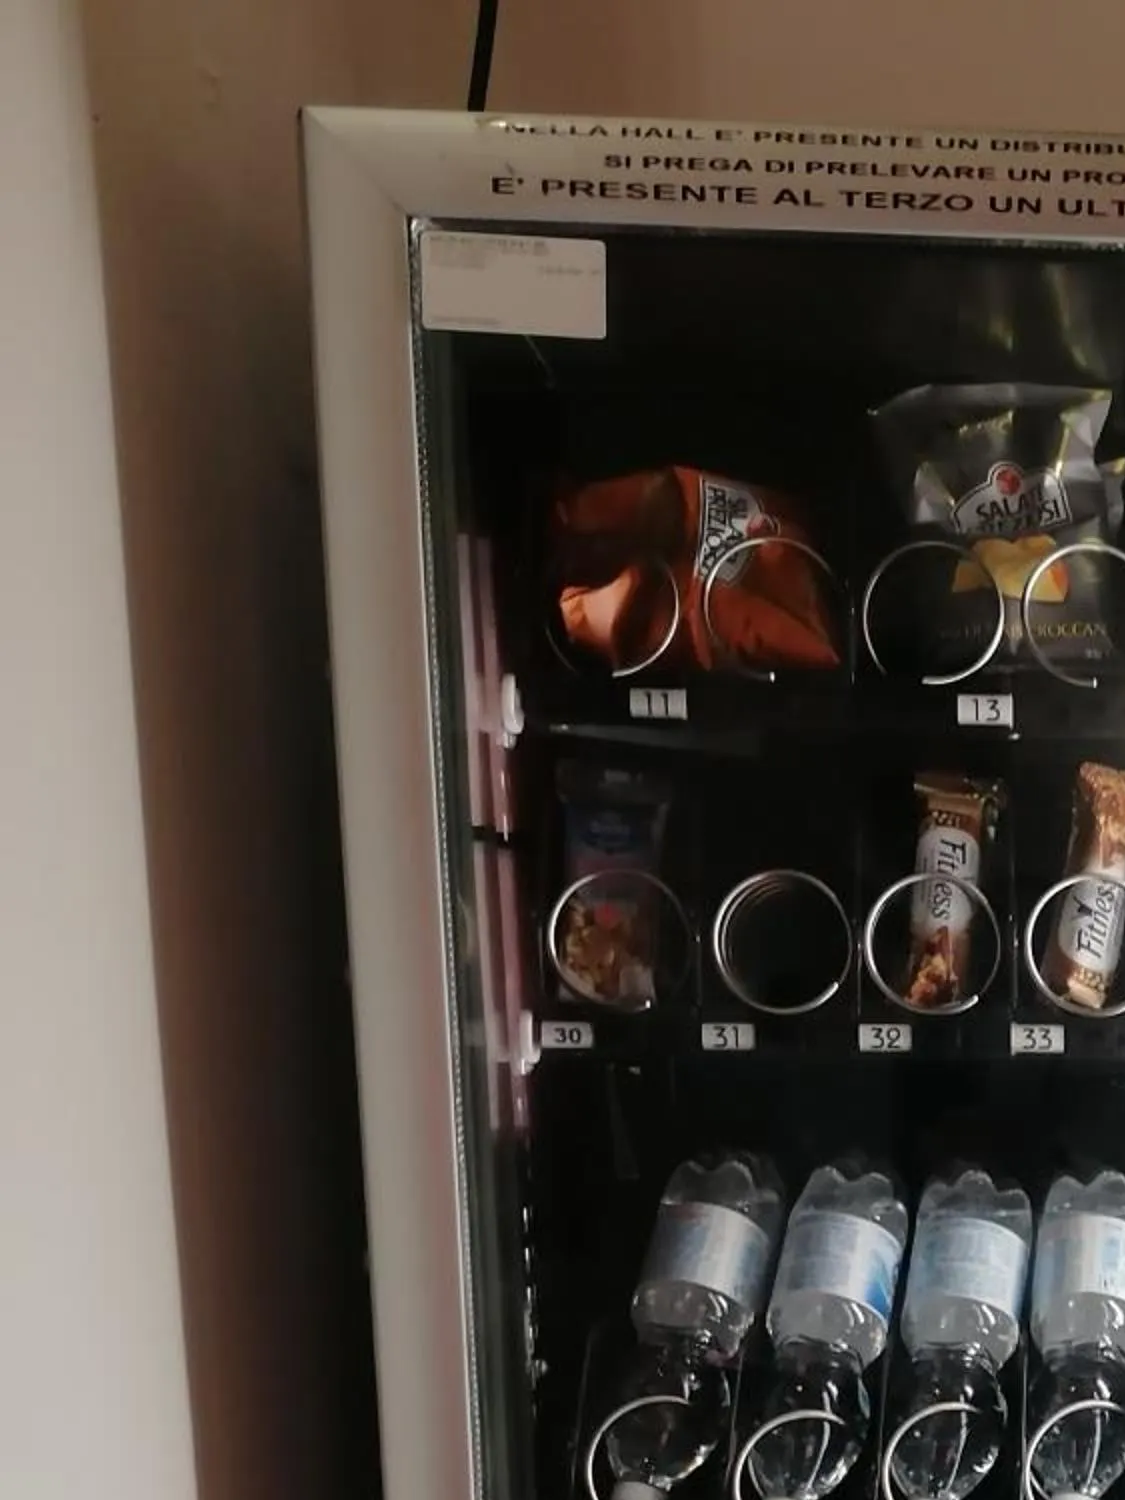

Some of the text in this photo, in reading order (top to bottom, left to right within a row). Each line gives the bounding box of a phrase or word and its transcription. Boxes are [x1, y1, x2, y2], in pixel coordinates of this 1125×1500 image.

[621, 125, 704, 141] HALL
[715, 128, 743, 142] E'
[753, 130, 923, 149] PRESENTE
[935, 136, 979, 150] UN
[604, 154, 631, 169] SI
[642, 155, 754, 173] PREGA
[765, 159, 795, 174] DI
[805, 160, 997, 180] PRELEVARE
[1007, 167, 1052, 183] UN
[491, 176, 525, 195] E'
[540, 179, 759, 205] PRESENTE
[773, 188, 824, 207] AL
[839, 189, 974, 212] TERZO
[989, 195, 1043, 215] UN
[645, 691, 669, 716] 11
[973, 698, 1001, 722] 13
[1075, 879, 1117, 959] Fitnes
[554, 1028, 581, 1044] 30
[712, 1026, 739, 1049] 31
[870, 1027, 900, 1049] 32
[1022, 1027, 1052, 1050] 33
